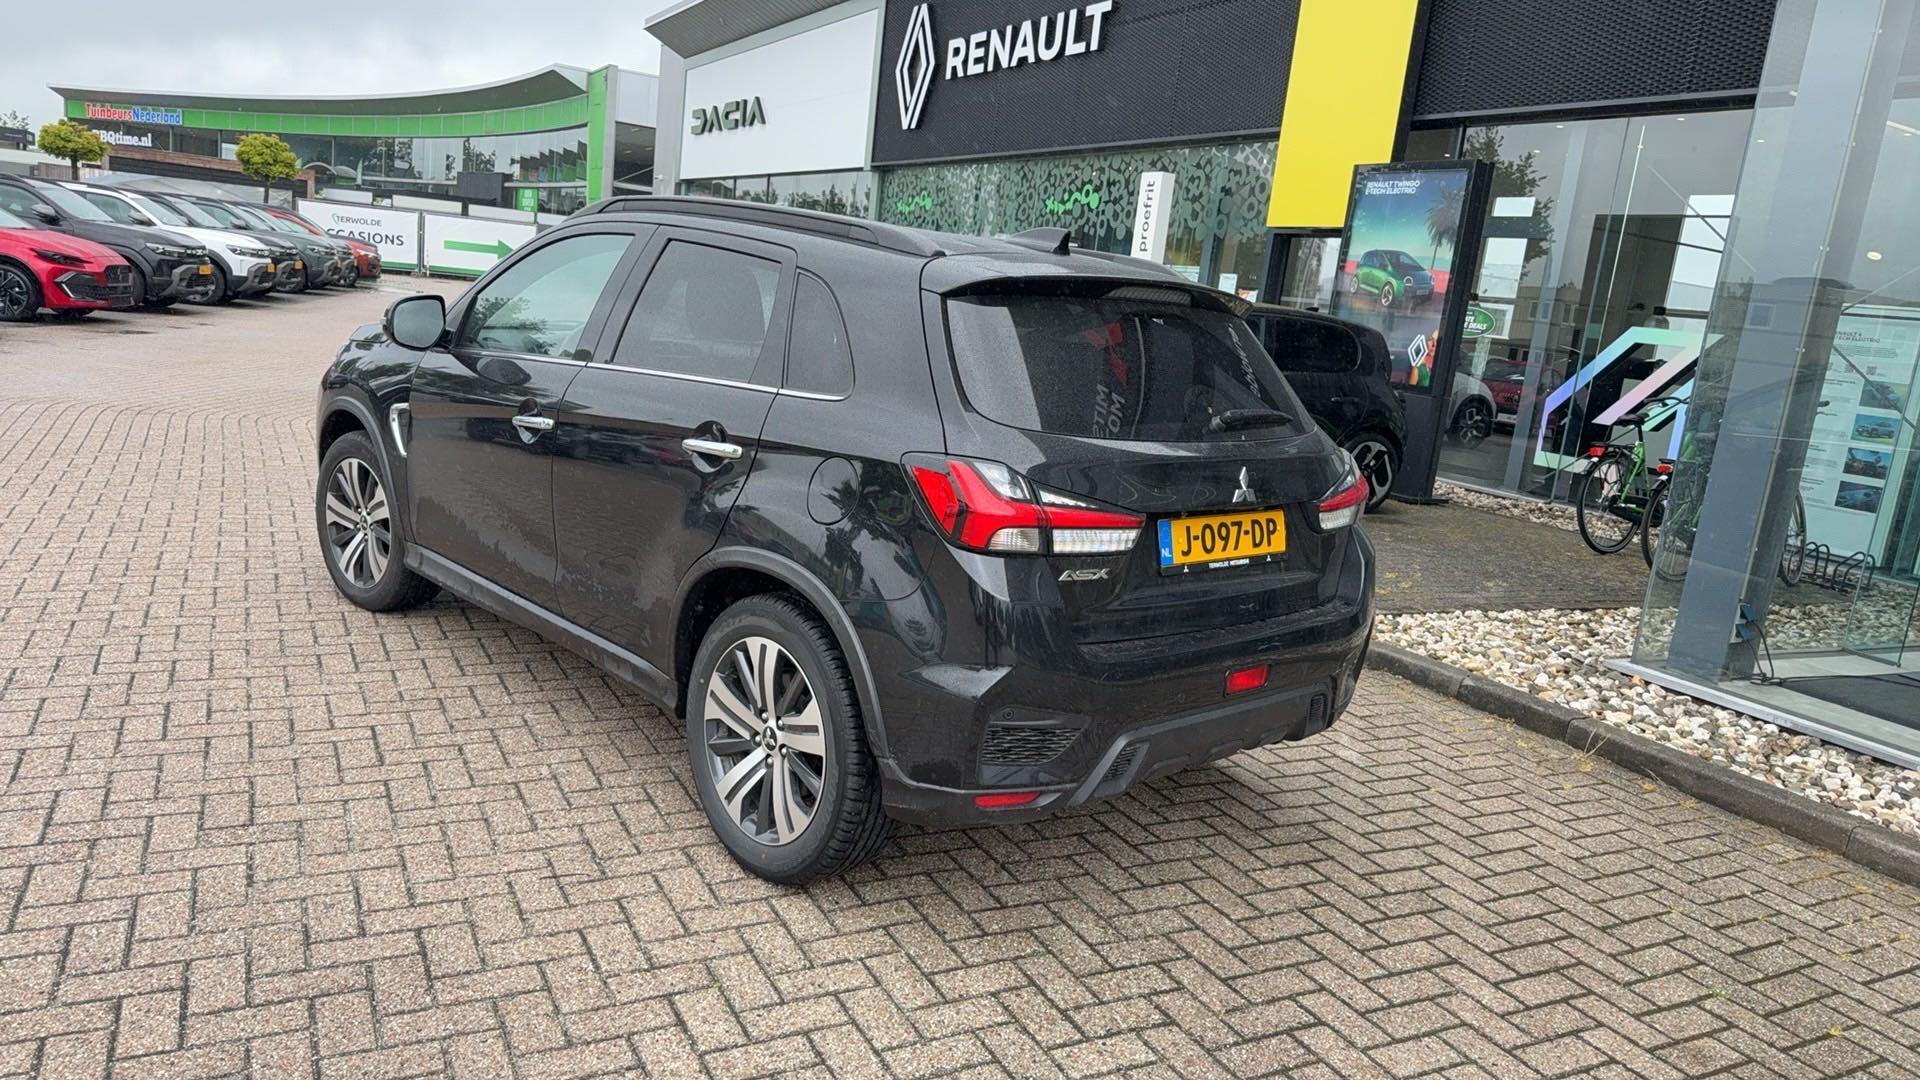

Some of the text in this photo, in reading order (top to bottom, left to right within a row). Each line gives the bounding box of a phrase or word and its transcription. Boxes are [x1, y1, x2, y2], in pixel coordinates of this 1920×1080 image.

[945, 0, 1113, 80] RENAULT
[85, 101, 183, 125] TuinbeursNederland
[691, 96, 766, 135] DACIA
[1394, 180, 1420, 188] TWINGO
[333, 214, 382, 227] TERWOLDE
[1139, 180, 1155, 252] proefrit
[1181, 517, 1278, 557] J-097-DP
[1161, 547, 1172, 558] NL
[1058, 567, 1111, 582] ASX
